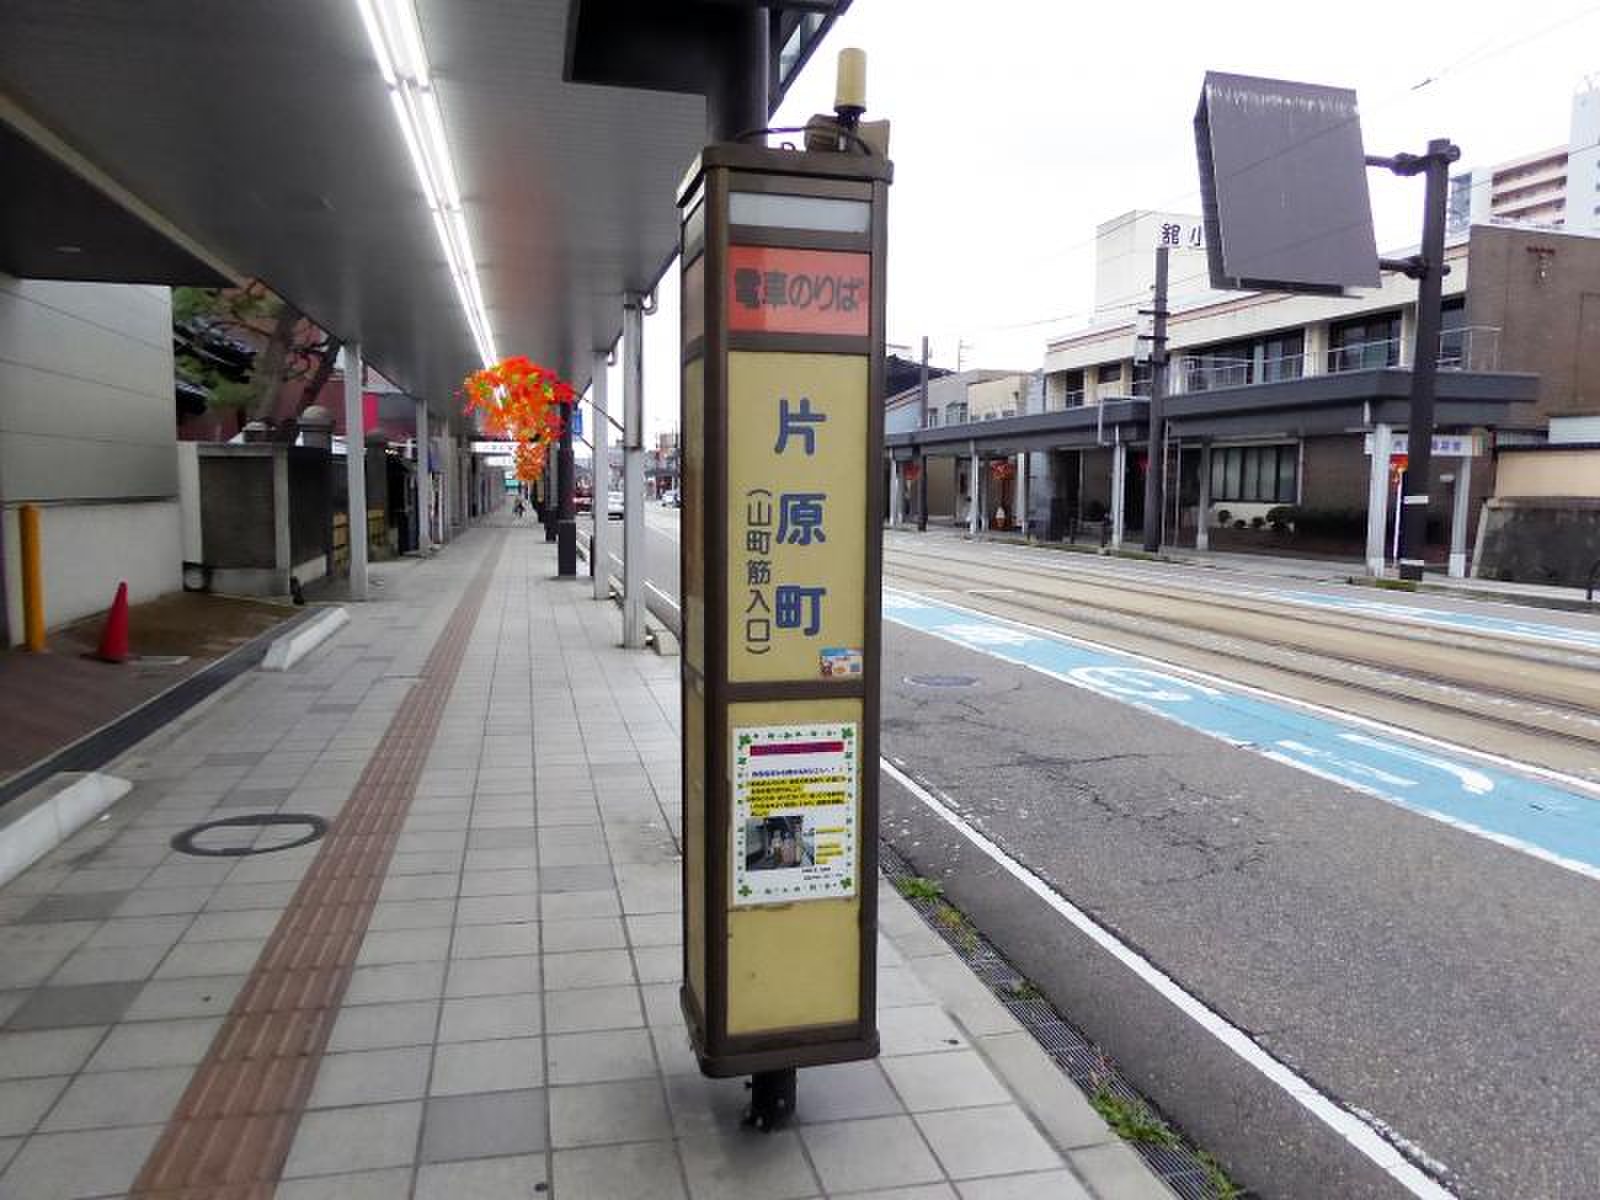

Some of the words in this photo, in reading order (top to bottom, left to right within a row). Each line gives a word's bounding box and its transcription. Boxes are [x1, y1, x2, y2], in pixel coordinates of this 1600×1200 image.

[736, 267, 865, 312] 電車のりば
[746, 488, 773, 655] (山町筋入口)
[773, 397, 828, 637] 片原町
